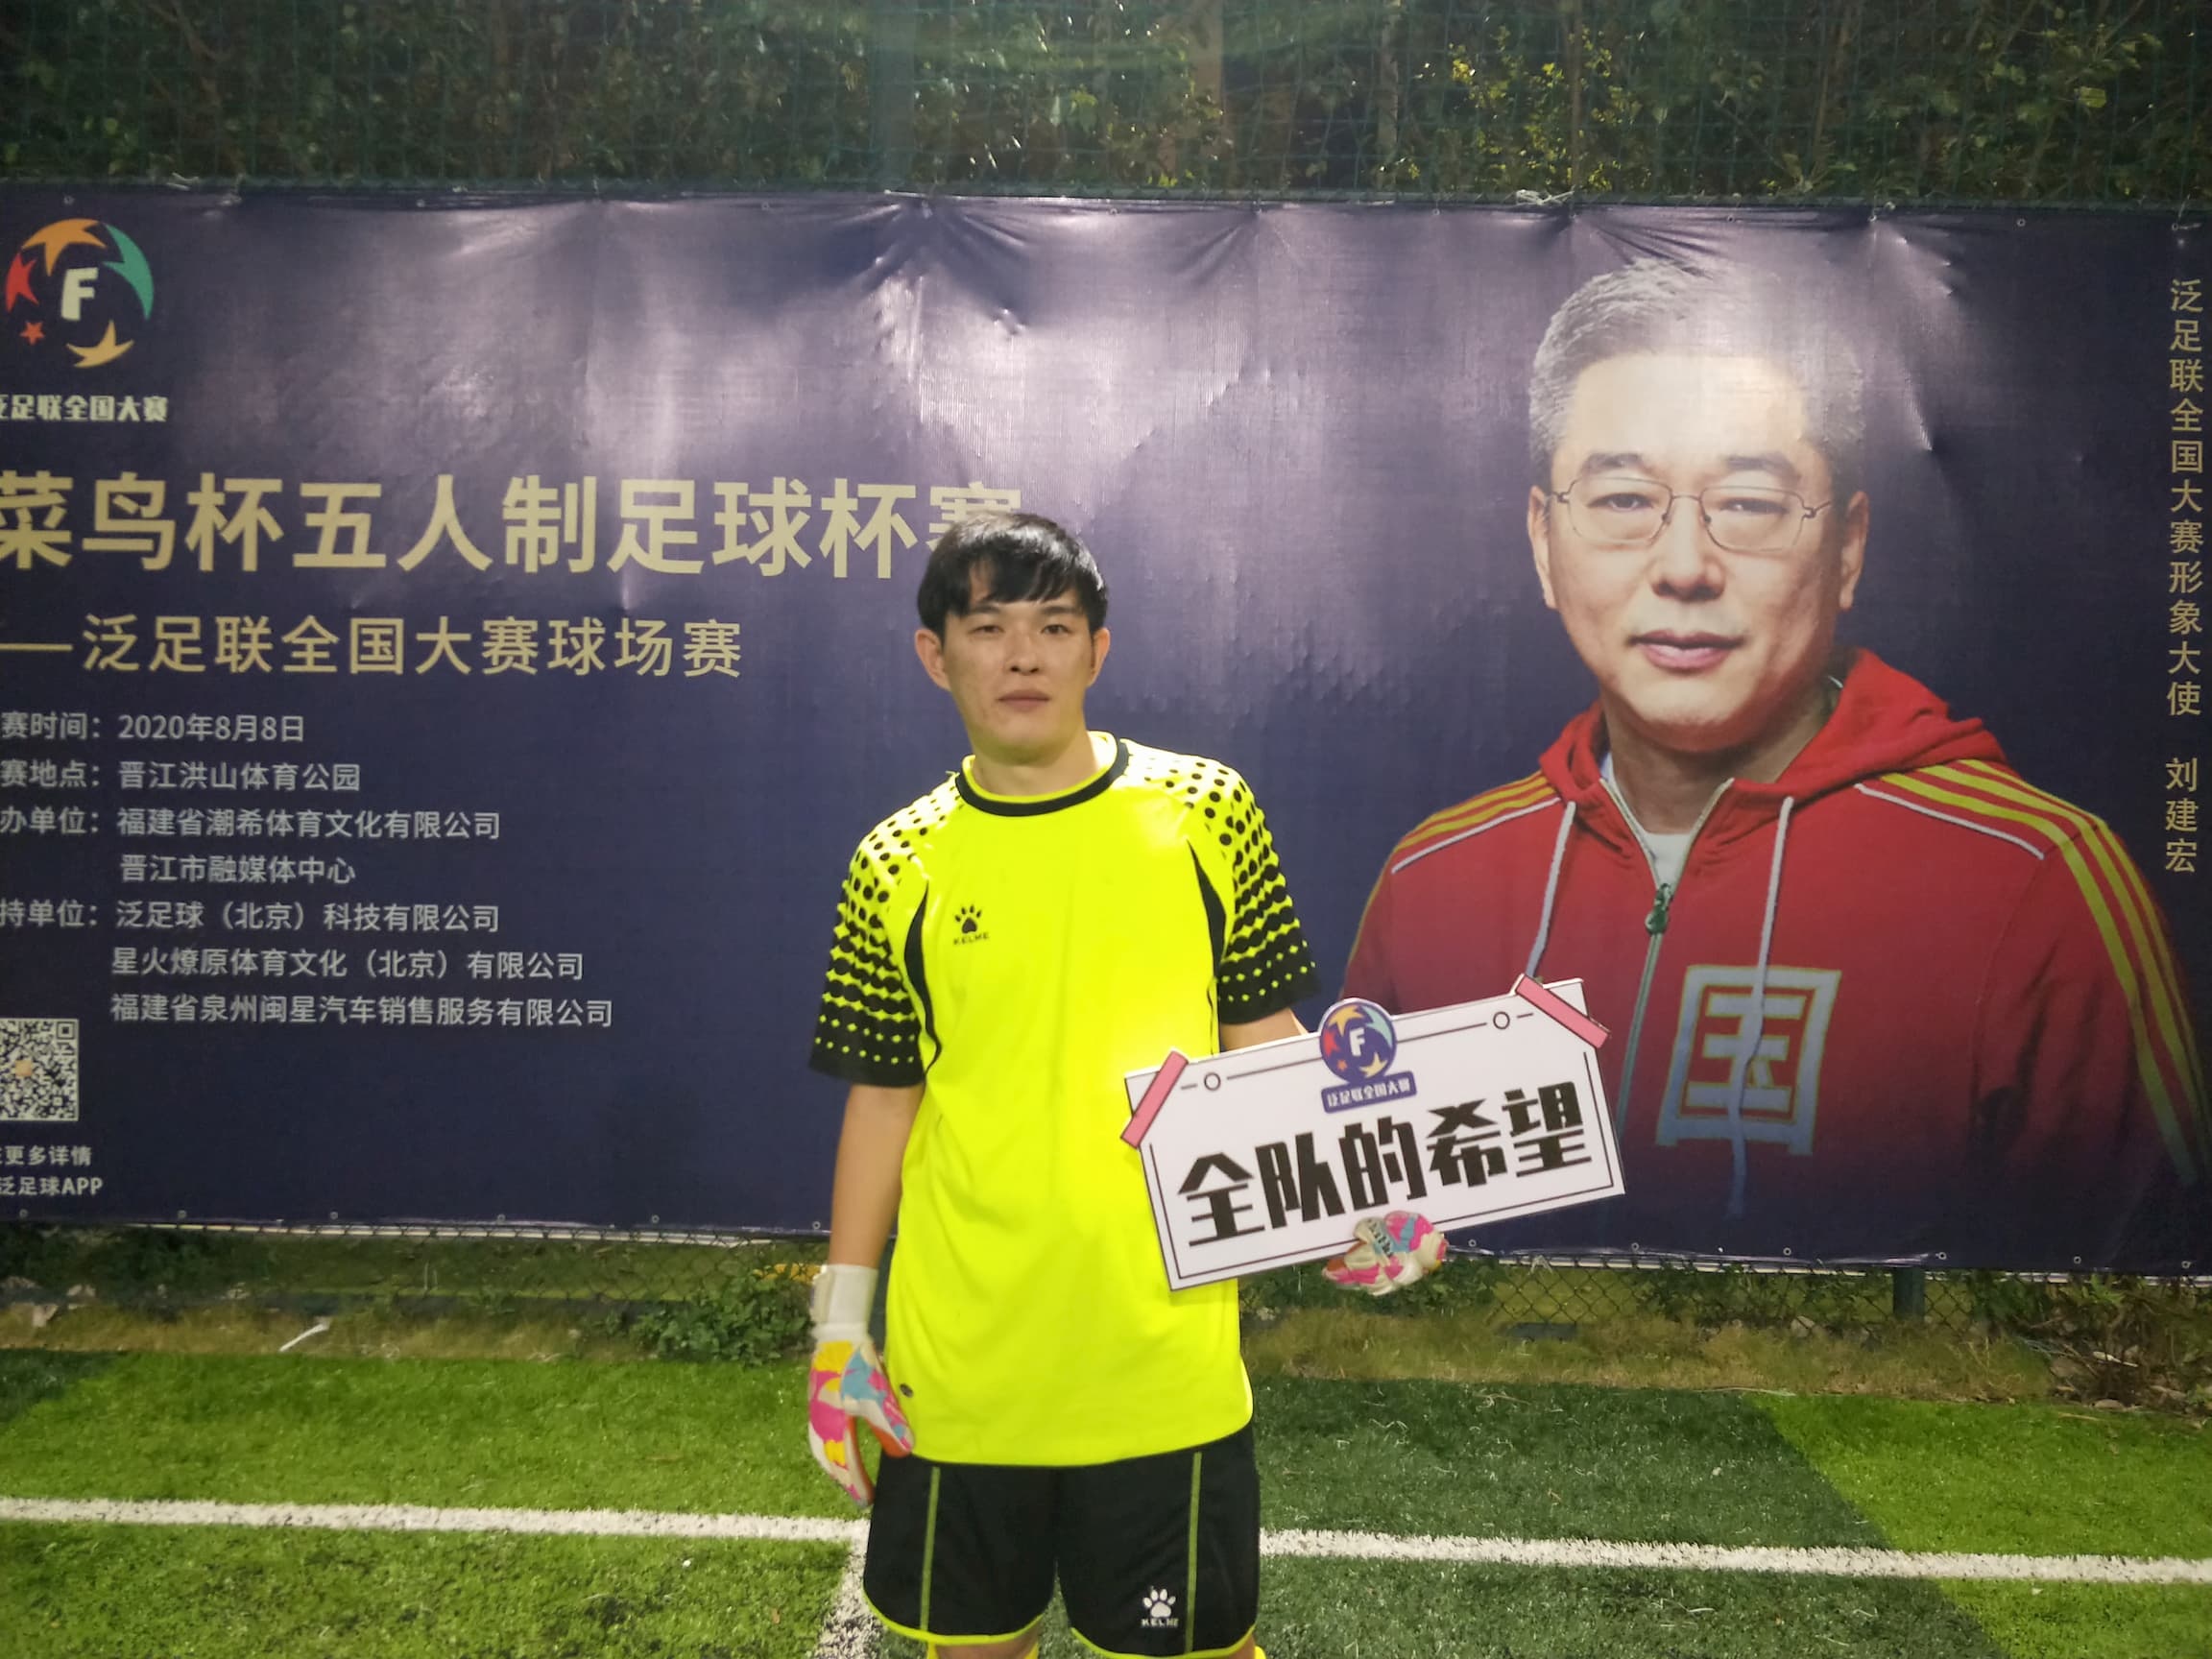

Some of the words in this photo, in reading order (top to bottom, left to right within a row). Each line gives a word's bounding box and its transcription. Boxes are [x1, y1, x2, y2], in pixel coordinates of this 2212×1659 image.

[60, 266, 99, 321] F
[2166, 278, 2204, 715] 泛足联全国大赛形象大使
[118, 713, 305, 742] 2020年8月8日
[117, 761, 361, 792] 晋江洪山体育公园
[117, 807, 500, 840] 福建省潮希体育文化有限公司
[2165, 757, 2199, 873] 刘建宏
[120, 854, 356, 884] 晋江市融媒体中心
[110, 994, 613, 1027] 福建省泉州闽星汽车销售服务有限公司
[1349, 1027, 1365, 1057] F
[1655, 964, 1843, 1156] 国
[0, 1145, 93, 1166] 更多详情
[1178, 1080, 1593, 1247] 全队的希望
